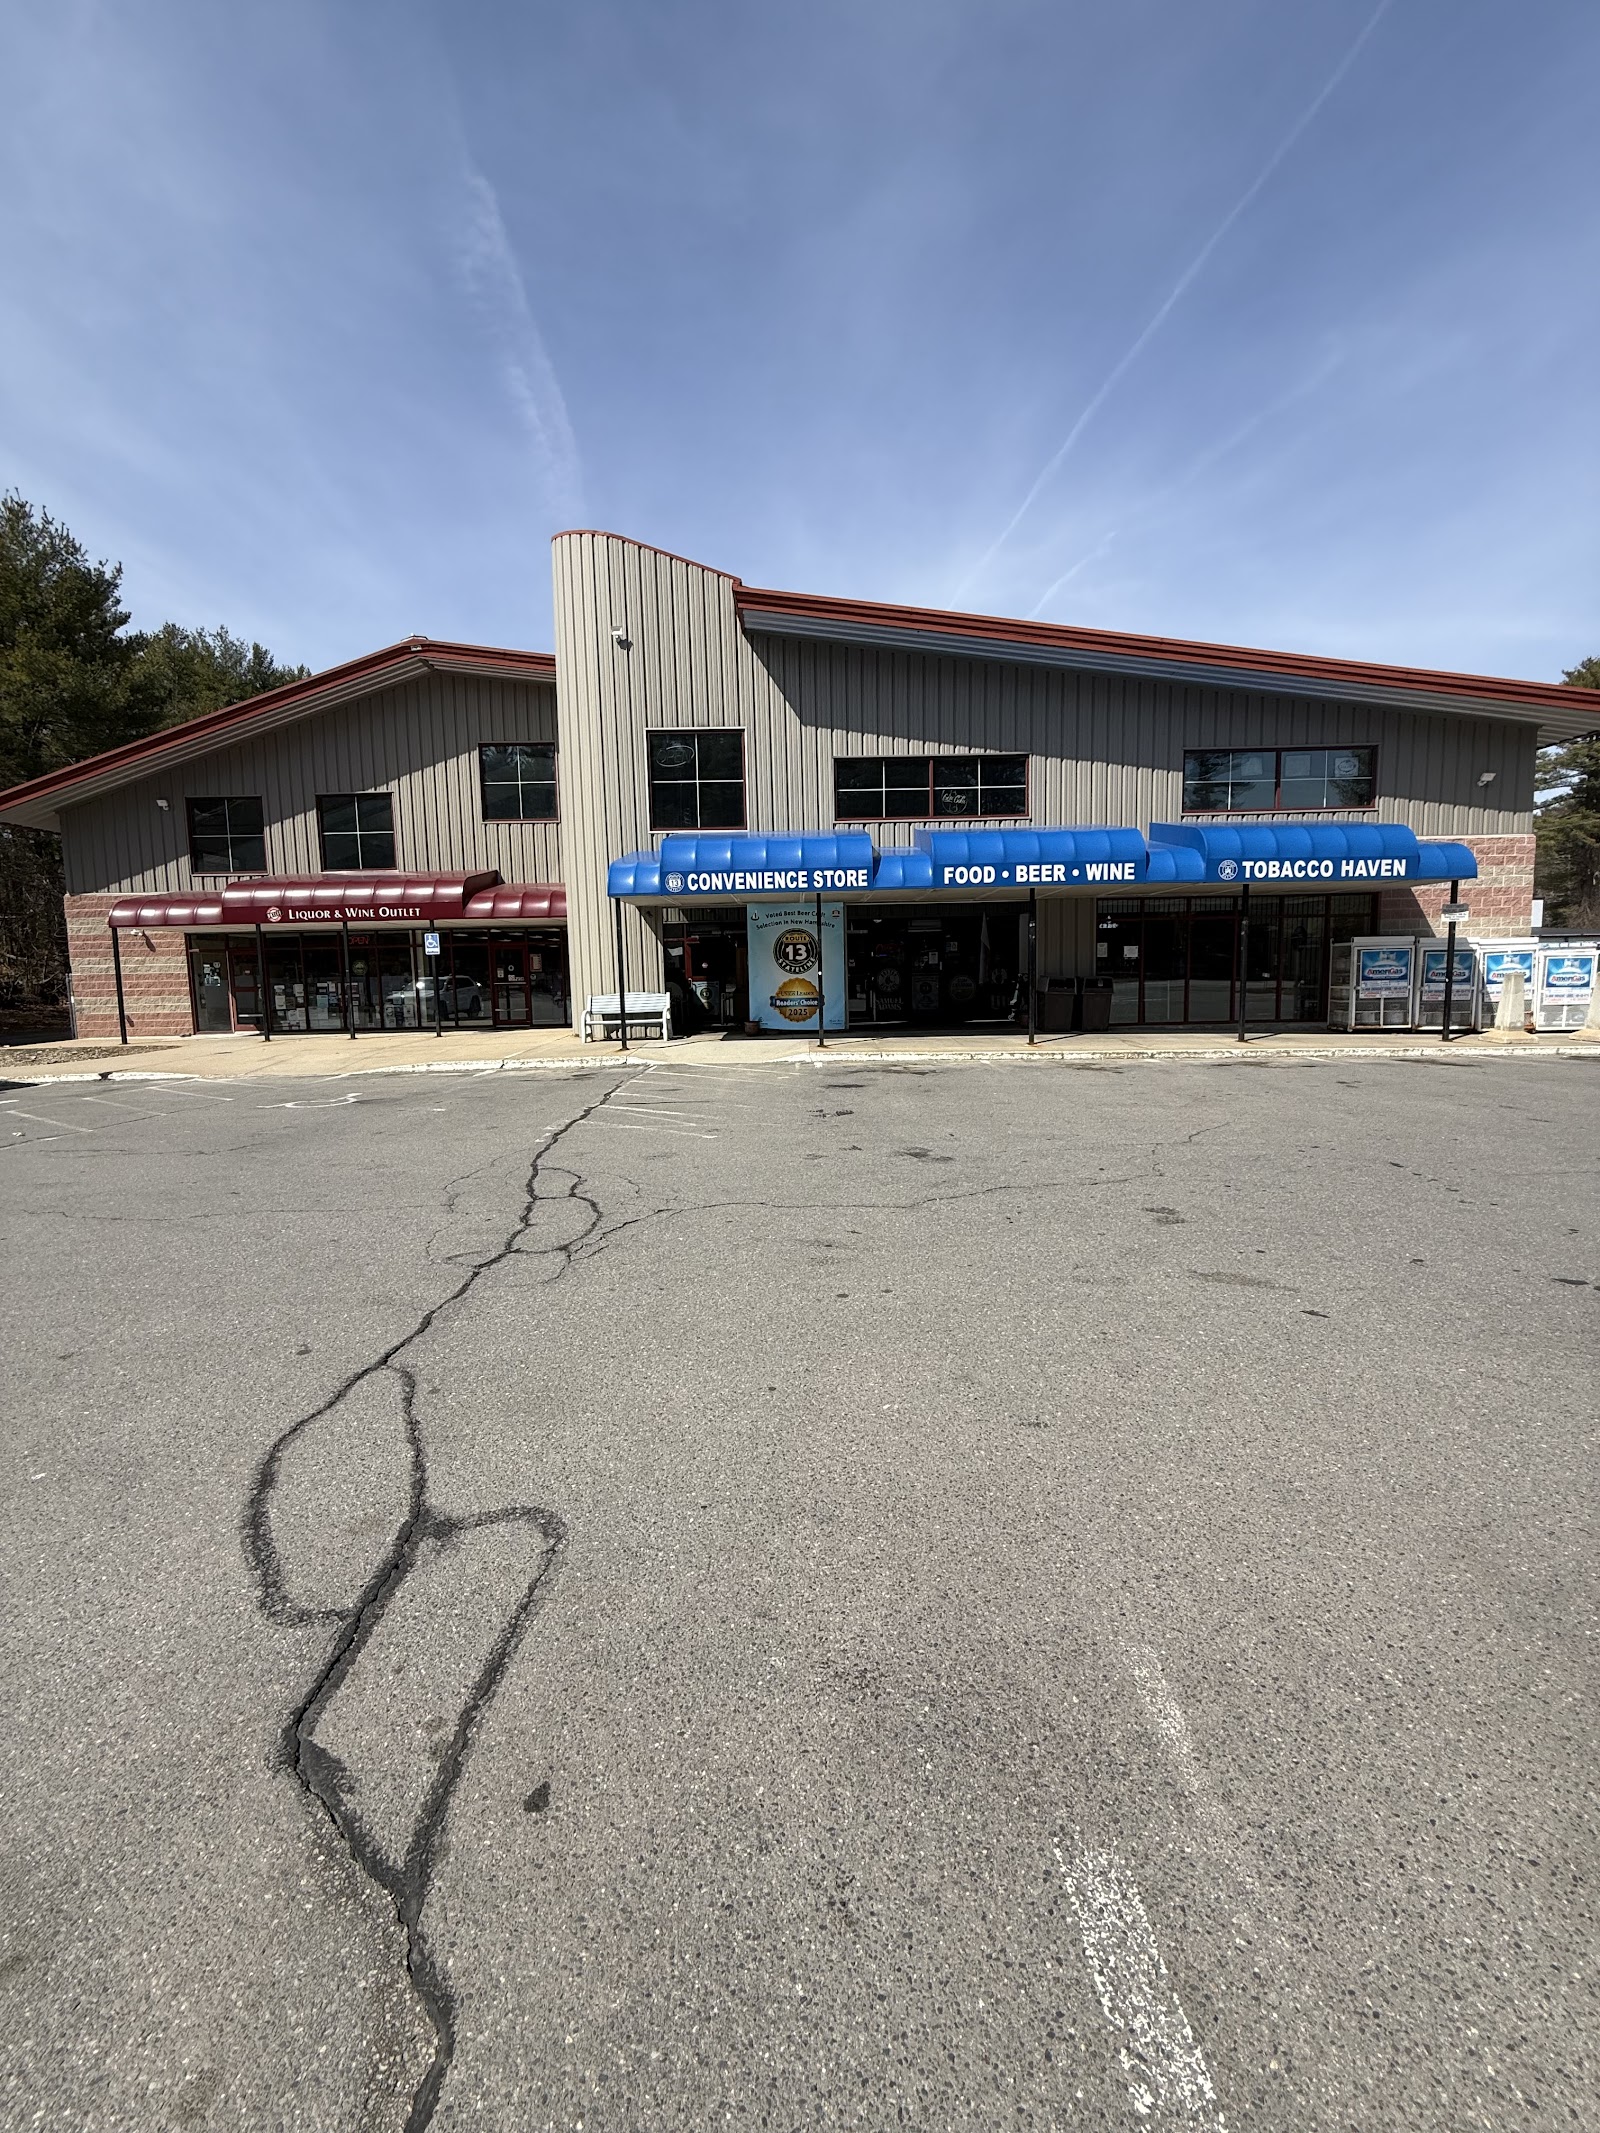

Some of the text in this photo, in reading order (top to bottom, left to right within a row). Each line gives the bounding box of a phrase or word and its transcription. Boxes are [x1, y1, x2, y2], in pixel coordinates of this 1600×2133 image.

[943, 862, 1135, 885] FOOD BEER WINE
[1242, 860, 1334, 878] TOBACCO
[1341, 859, 1407, 877] HAVEN
[687, 869, 868, 891] CONVENIENCE STORE
[334, 909, 343, 918] &
[756, 920, 783, 930] Selection
[804, 919, 836, 929] Hamshire
[785, 944, 808, 960] 13
[778, 957, 816, 972] STATELINE
[1366, 968, 1403, 976] AmeriGas
